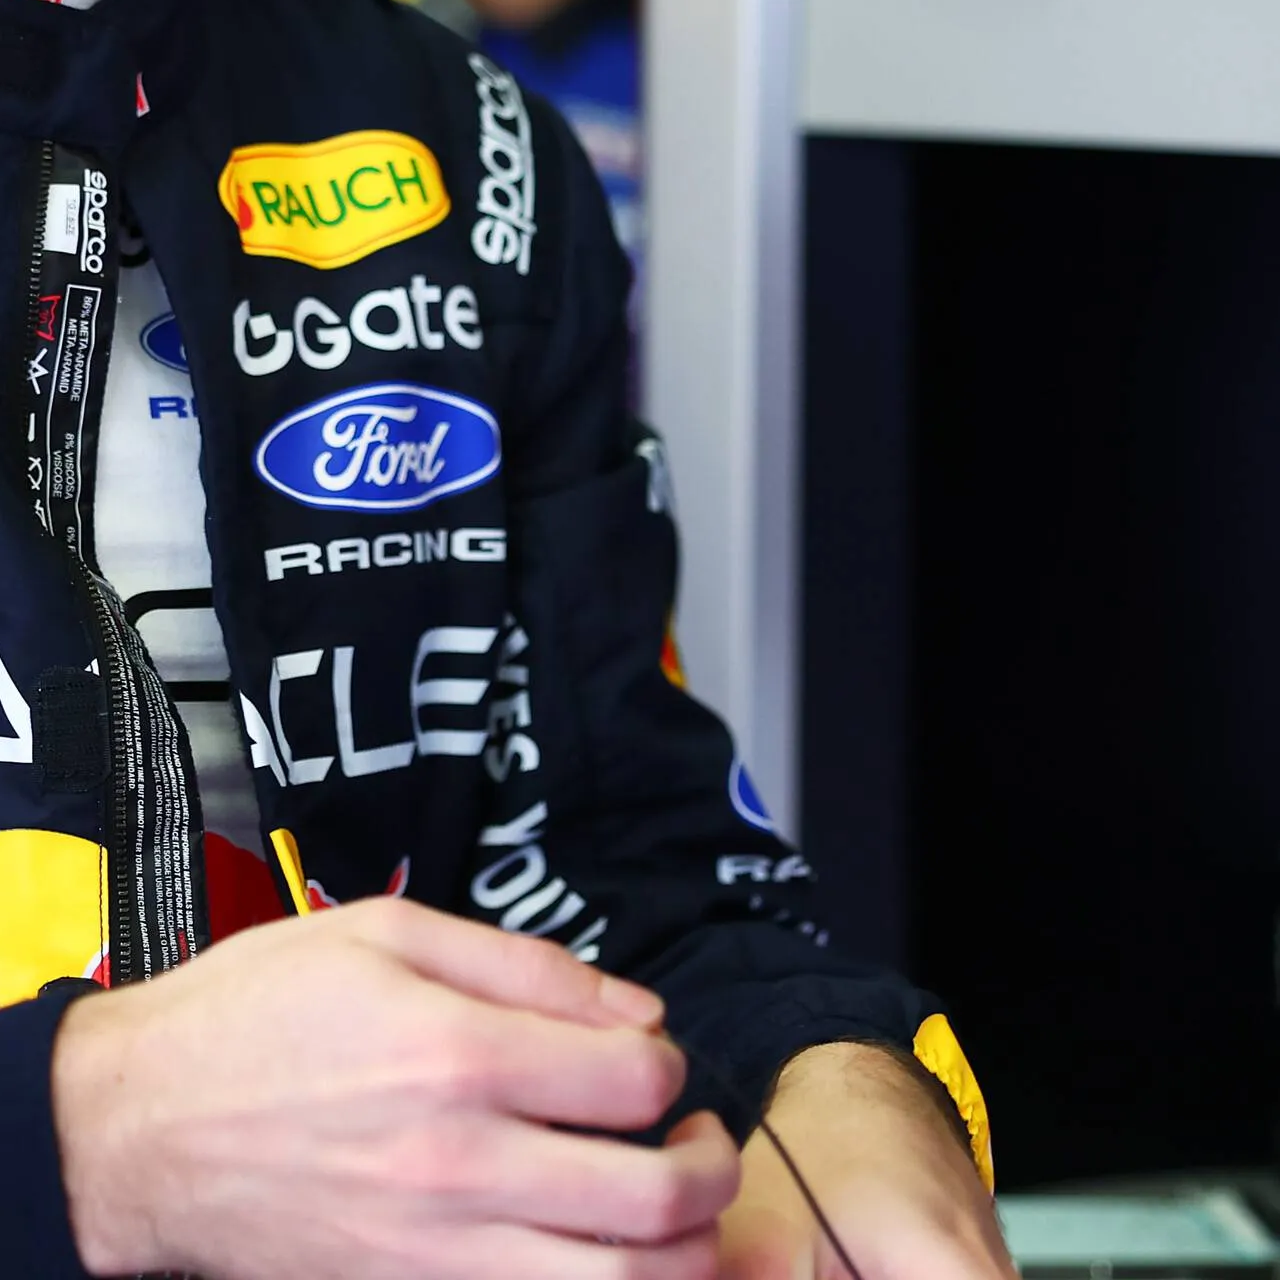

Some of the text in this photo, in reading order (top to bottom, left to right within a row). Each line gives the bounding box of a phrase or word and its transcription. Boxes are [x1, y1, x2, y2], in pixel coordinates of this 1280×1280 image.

[252, 156, 430, 231] RAUCH
[84, 170, 107, 274] sparco
[293, 275, 486, 371] Gate
[59, 318, 77, 393] META-ARAMID
[70, 296, 93, 402] 86% META-ARAMIDE
[314, 404, 451, 492] Ford
[53, 451, 62, 498] VISCOSE
[64, 452, 75, 500] VISCOSA
[264, 528, 507, 582] RACING
[129, 681, 137, 695] AND
[132, 696, 140, 715] HEAT
[122, 691, 130, 709] WITH
[127, 748, 135, 791] STANDARD.
[155, 785, 163, 806] CAPO
[173, 800, 180, 808] TO
[180, 786, 189, 825] EXTREMELY
[154, 816, 163, 835] CASO
[163, 799, 171, 849] PERFORMANTI
[172, 810, 180, 841] REPLACE
[153, 845, 161, 867] SEGNI
[173, 850, 180, 861] DO
[181, 826, 189, 869] PERFORMING
[163, 850, 172, 886] SOGGETTI
[136, 877, 146, 922] PROTECTION
[155, 877, 163, 902] USURA
[183, 871, 192, 909] MATERIALS
[140, 923, 150, 952] AGAINST
[157, 904, 167, 938] EVIDENTE
[185, 911, 195, 942] SUBJECT
[143, 953, 151, 972] HEAT
